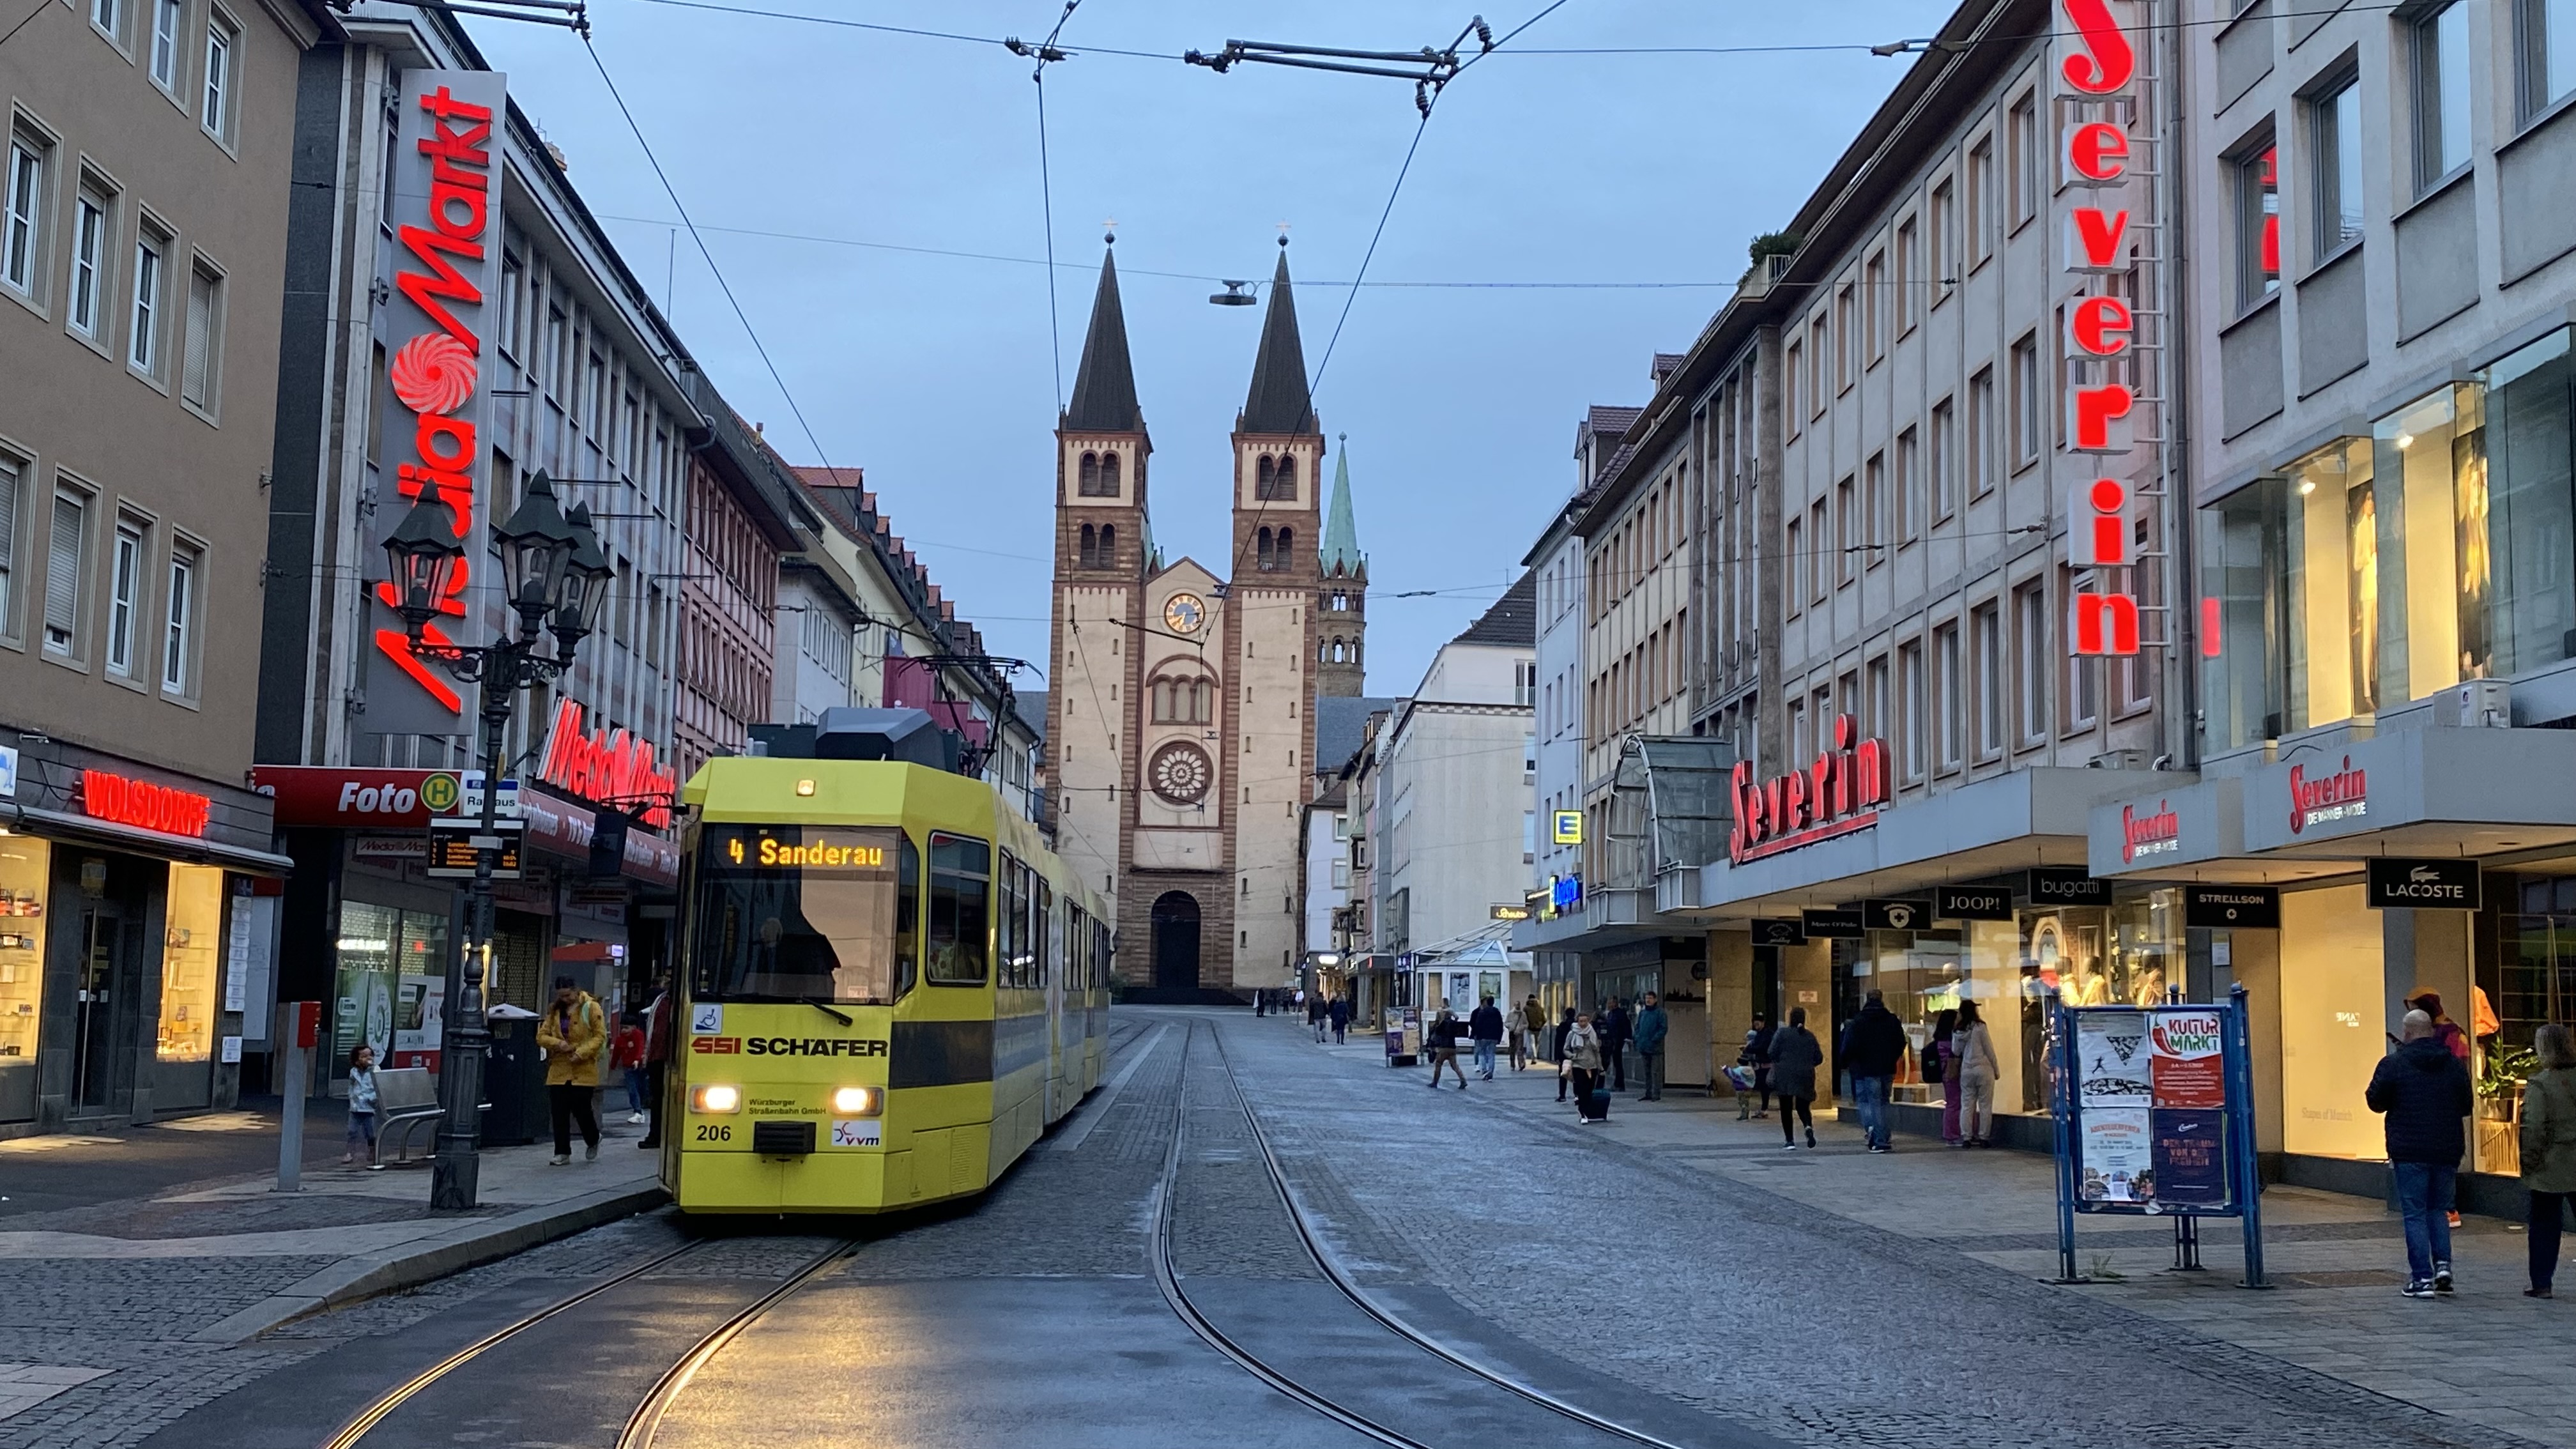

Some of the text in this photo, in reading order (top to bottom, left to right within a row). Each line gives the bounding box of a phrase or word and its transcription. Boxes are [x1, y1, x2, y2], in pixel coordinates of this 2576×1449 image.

[396, 86, 493, 356] Markt
[2062, 0, 2140, 655] Severin
[338, 781, 416, 813] Foto
[431, 783, 449, 802] H
[1729, 712, 1890, 864] Severin
[2290, 755, 2366, 834] Severin
[84, 769, 210, 838] WOLSDORFF
[467, 796, 516, 807] Raaus
[2122, 798, 2178, 864] Severin
[728, 838, 883, 866] 4 Sanderau
[2041, 878, 2099, 897] bugatti
[2386, 884, 2464, 898] LACOSTE
[1947, 896, 2000, 910] JOOP!
[2199, 894, 2264, 905] STRELLSON
[2168, 1018, 2220, 1034] KULTUR
[691, 1037, 888, 1057] SSI SCHÄFER
[2170, 1034, 2220, 1052] MARKT
[749, 1098, 795, 1107] Würzburger
[749, 1107, 827, 1116] Straßenbahn GmbH
[696, 1124, 732, 1142] 206
[847, 1136, 880, 1146] vvm
